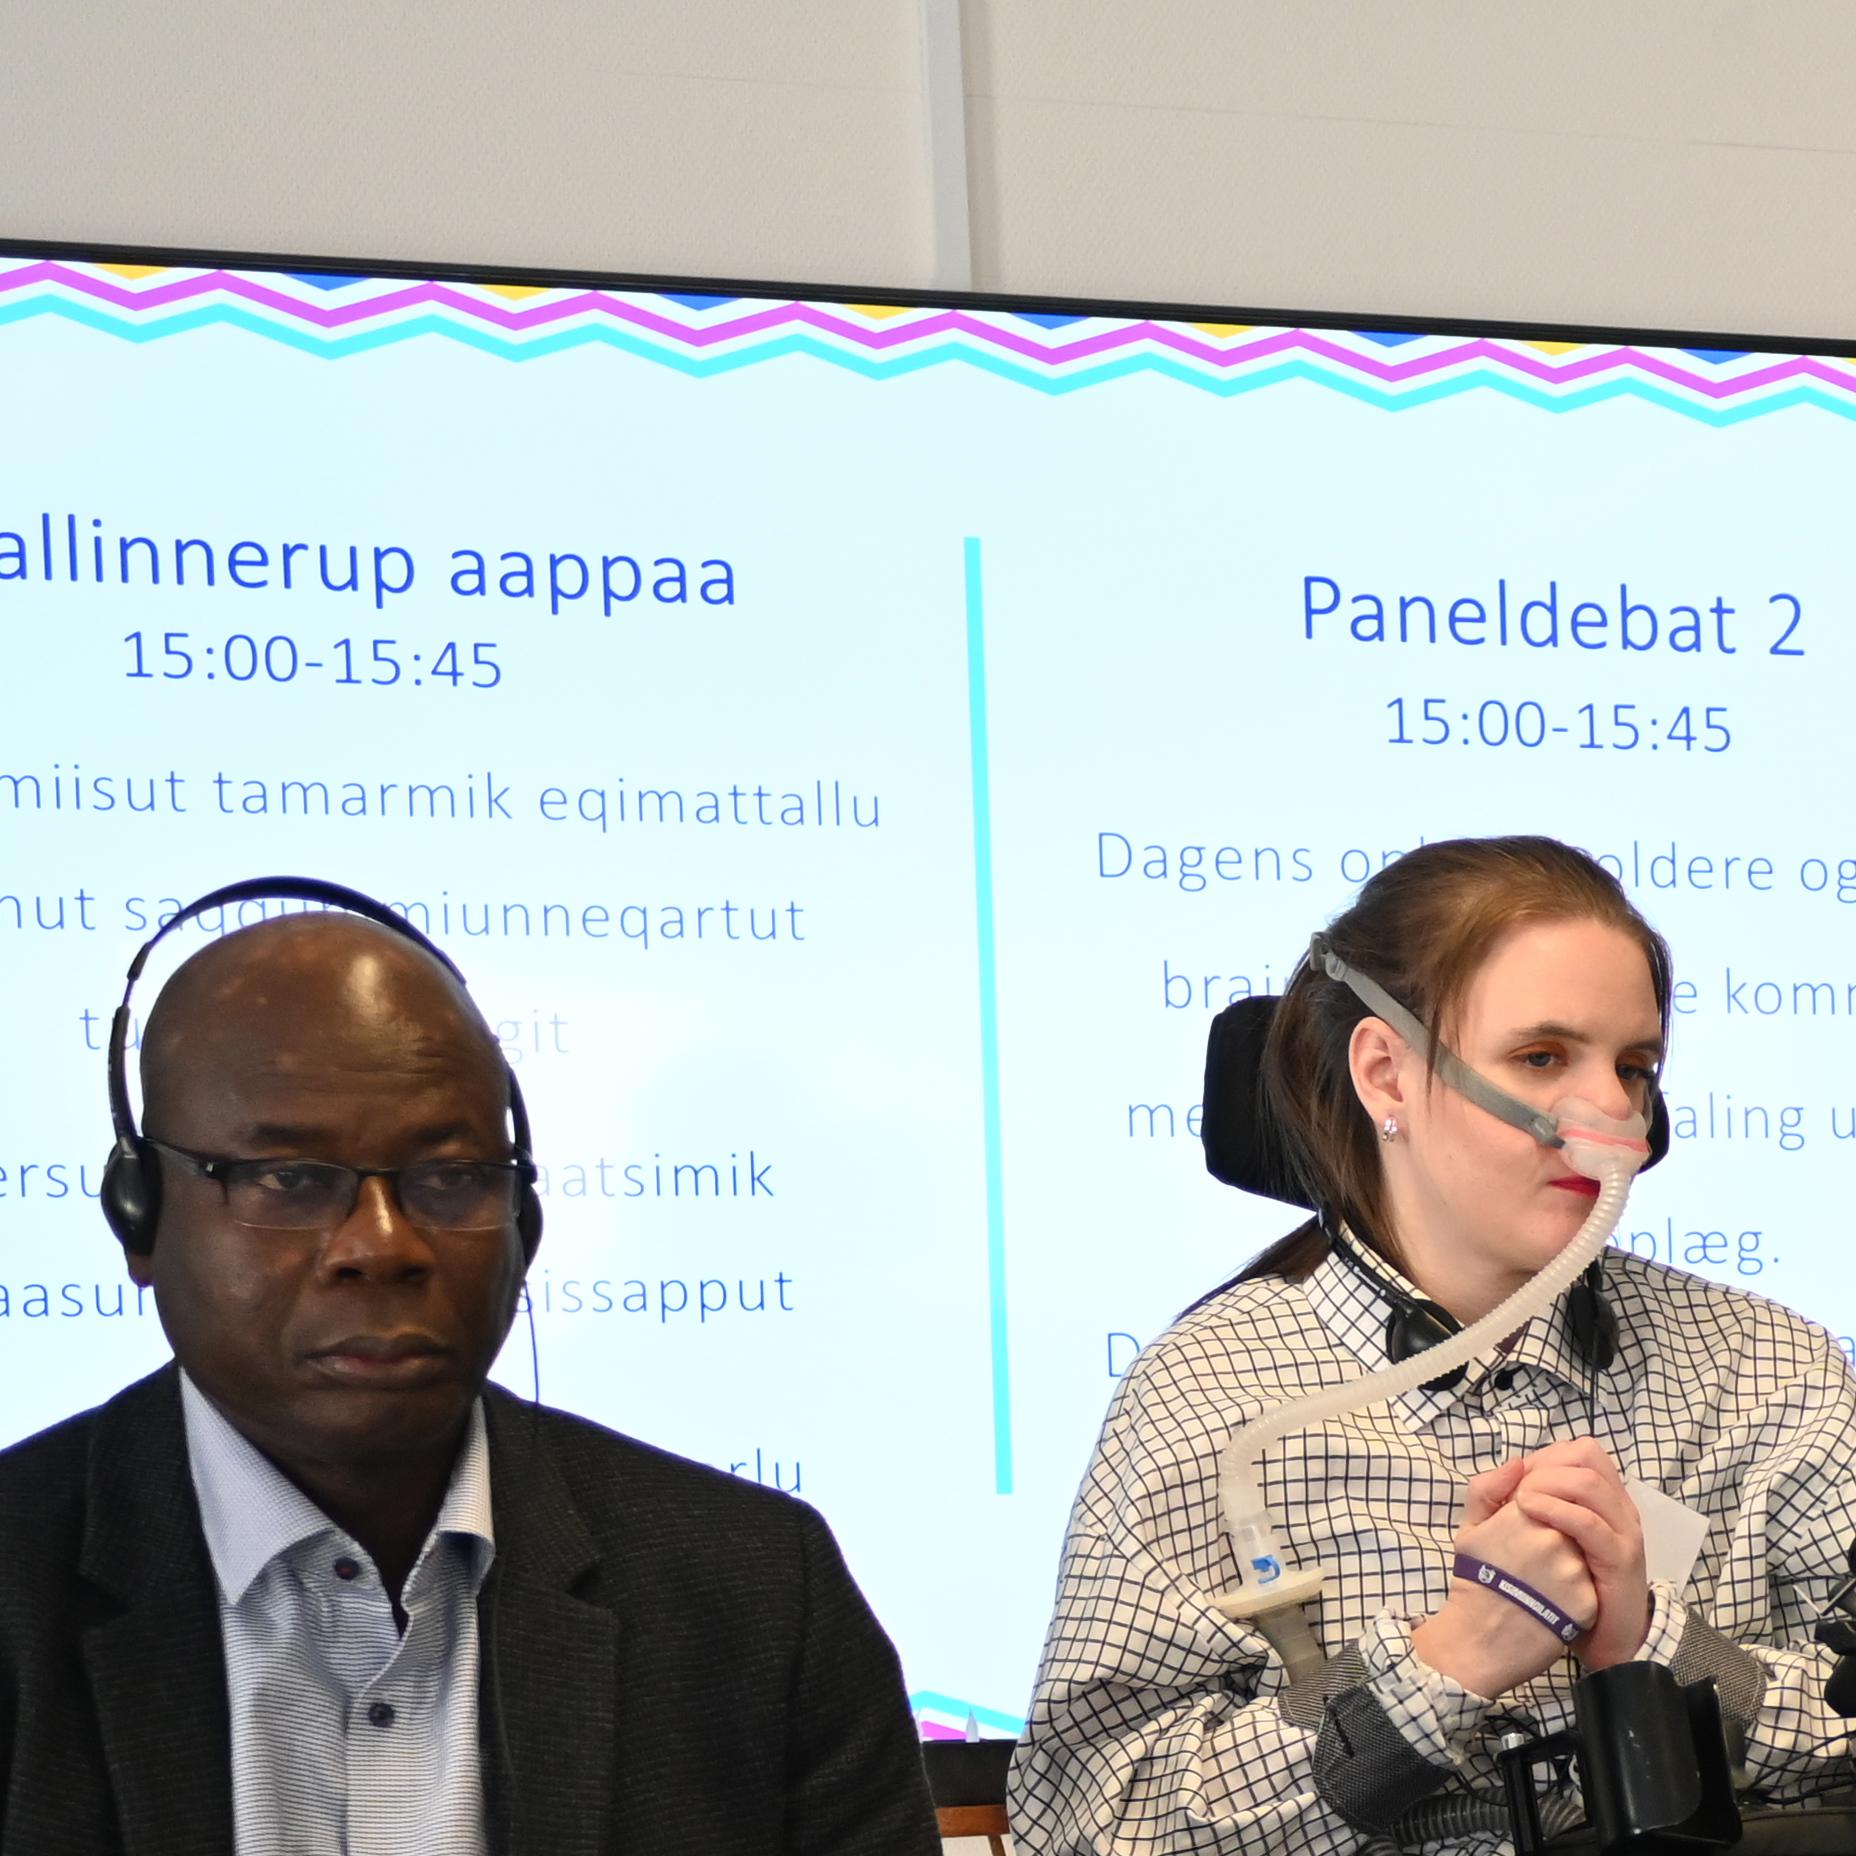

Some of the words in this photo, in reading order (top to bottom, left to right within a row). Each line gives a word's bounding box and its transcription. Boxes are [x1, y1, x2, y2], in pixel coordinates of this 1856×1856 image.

[449, 548, 736, 618] aappaa
[1303, 575, 1738, 655] Paneldebat
[1768, 592, 1807, 657] 2
[123, 630, 503, 690] 15:00-15:45
[1386, 696, 1732, 754] 15:00-15:45
[211, 770, 513, 820] tamarmik
[539, 777, 882, 834] eqimattallu
[1097, 832, 1313, 892] Dagens
